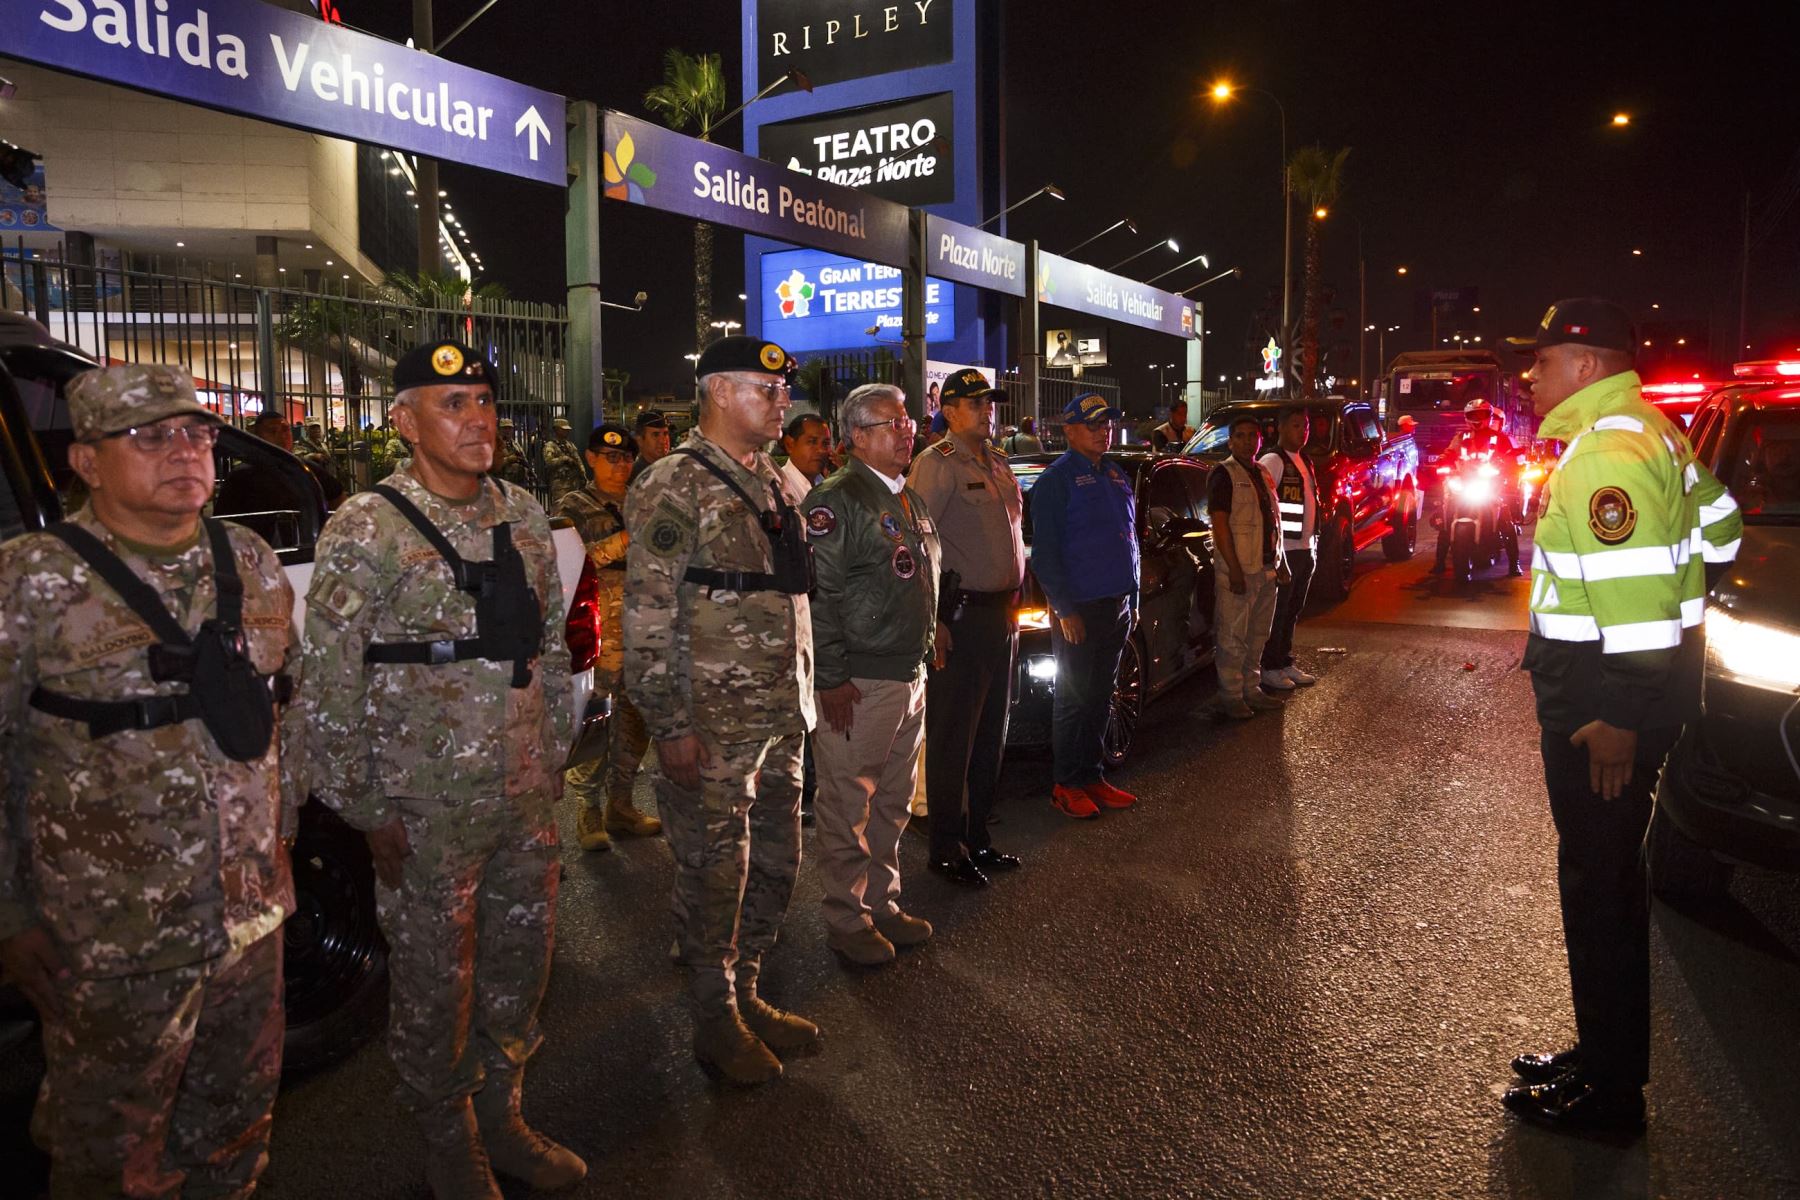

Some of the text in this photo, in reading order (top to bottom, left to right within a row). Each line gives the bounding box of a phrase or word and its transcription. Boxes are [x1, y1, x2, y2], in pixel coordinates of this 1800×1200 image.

[772, 0, 933, 57] RIPLEY
[269, 33, 494, 141] Vehicular
[813, 119, 936, 163] TEATRO
[817, 152, 937, 188] Plaza Norte
[693, 161, 866, 239] Salida Peatonal
[819, 267, 862, 285] GRAN
[939, 233, 1016, 280] Plaza Norte
[1086, 280, 1164, 321] Salida Vehicular
